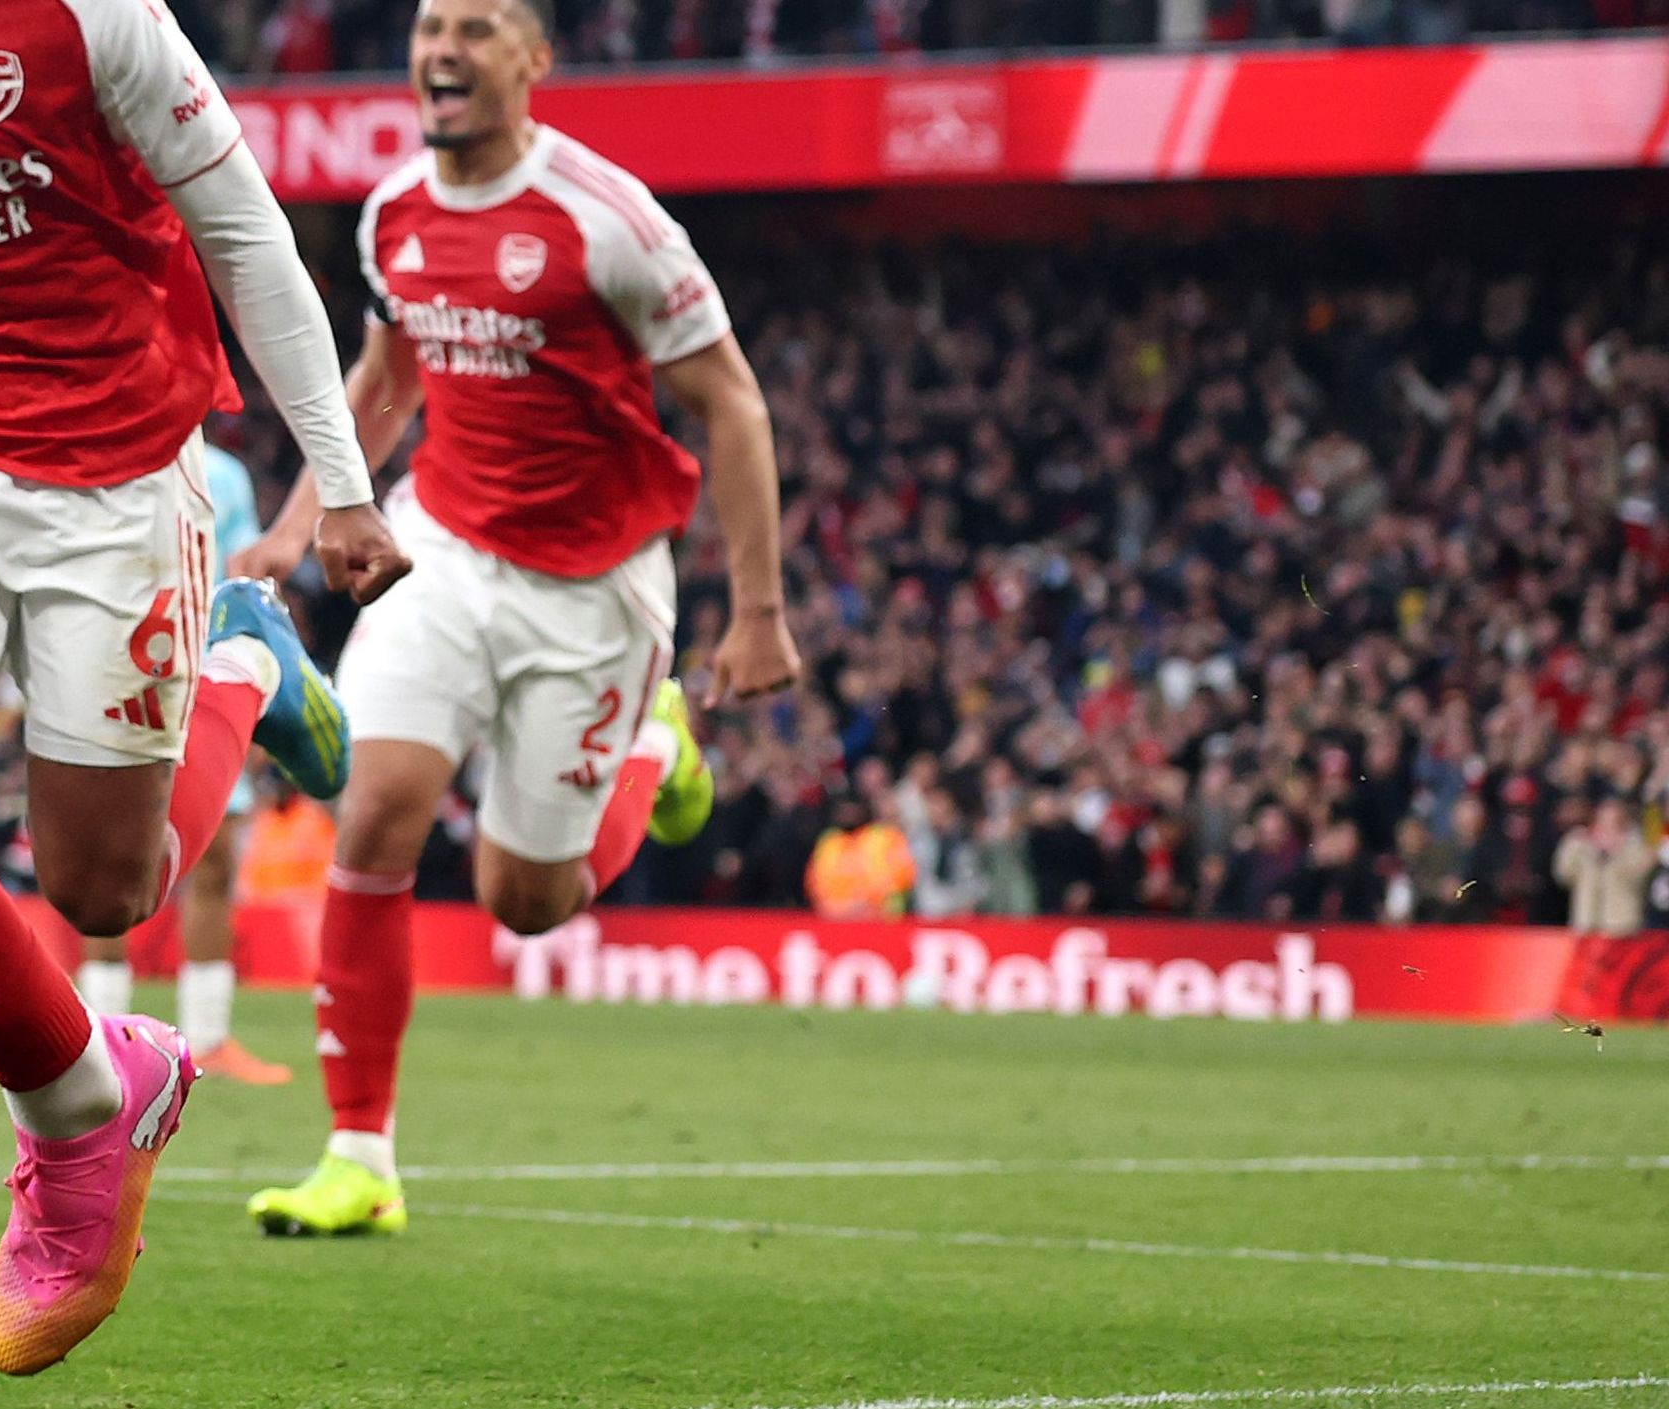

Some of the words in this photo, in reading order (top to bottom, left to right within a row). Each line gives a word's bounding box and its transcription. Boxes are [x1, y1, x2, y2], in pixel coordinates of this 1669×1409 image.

[128, 586, 178, 681] 6
[580, 686, 623, 755] 2
[491, 912, 768, 1005] Time
[777, 929, 899, 1011] to
[911, 926, 1355, 1023] Refresh
